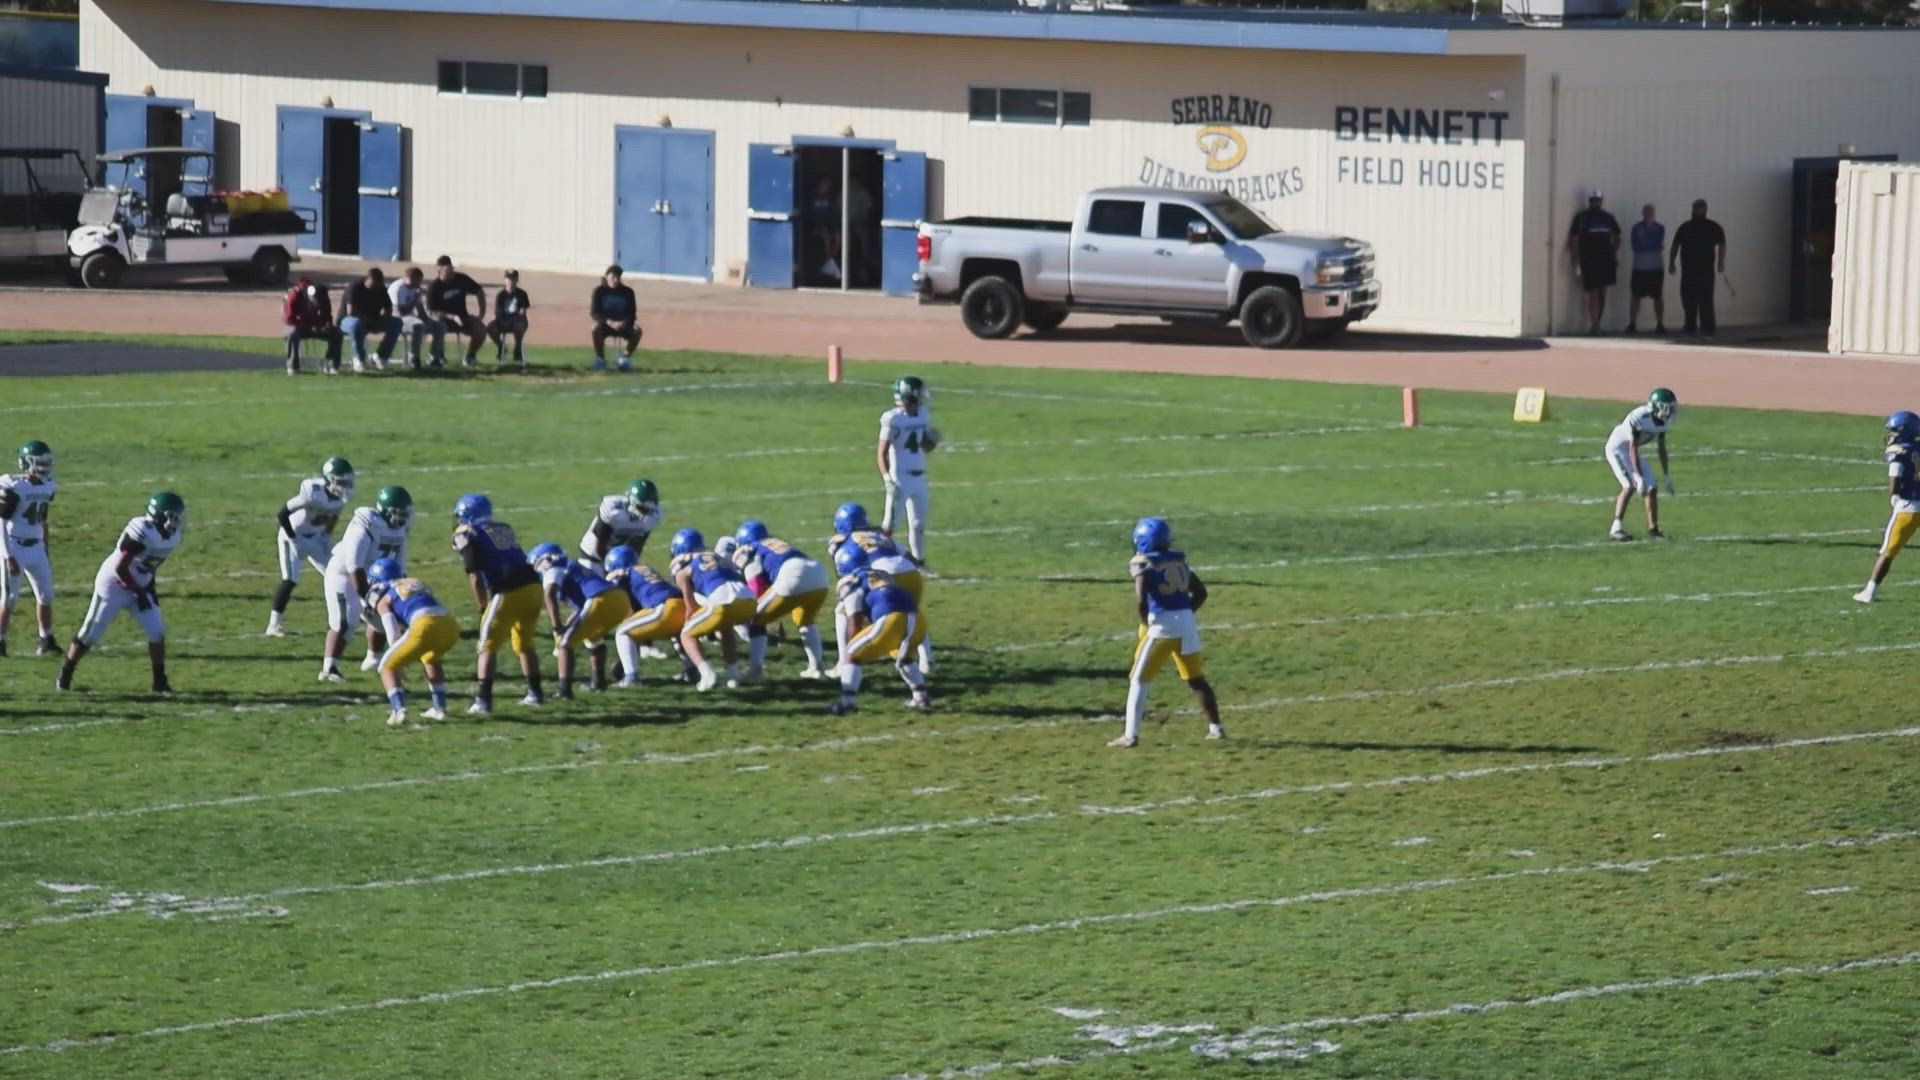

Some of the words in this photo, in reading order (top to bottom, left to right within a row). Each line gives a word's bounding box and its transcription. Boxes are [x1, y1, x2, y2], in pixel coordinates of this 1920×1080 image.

[1171, 93, 1273, 129] SERRANO
[1335, 106, 1510, 148] BENNETT
[1338, 156, 1404, 186] FIELD
[1419, 159, 1504, 190] HOUSE
[1523, 391, 1536, 416] G
